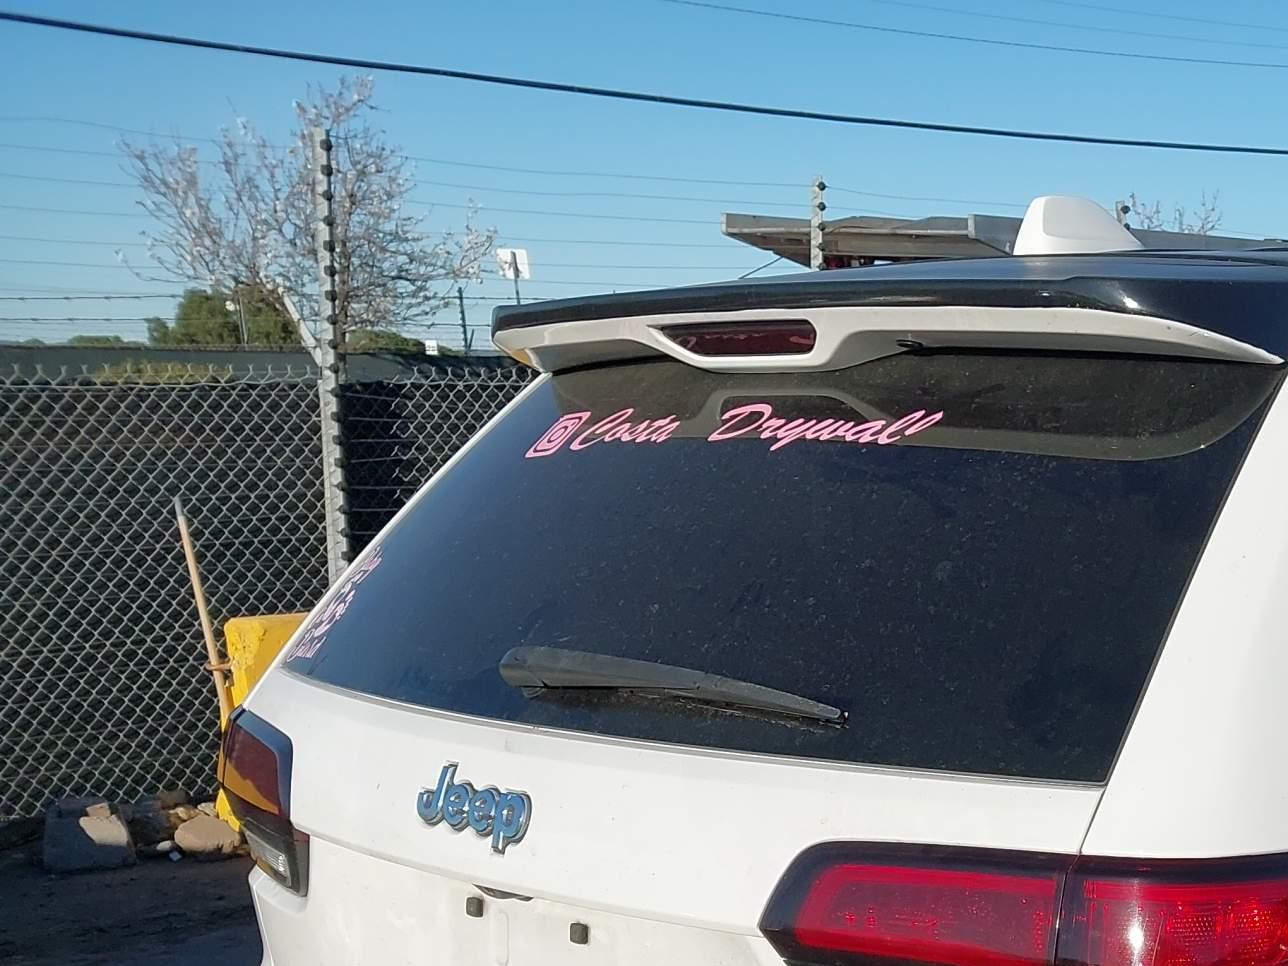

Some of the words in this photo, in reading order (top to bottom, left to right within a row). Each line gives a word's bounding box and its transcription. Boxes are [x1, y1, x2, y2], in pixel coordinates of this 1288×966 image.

[569, 408, 681, 451] Costa
[707, 403, 944, 451] Drywall
[416, 760, 532, 856] Jeep
